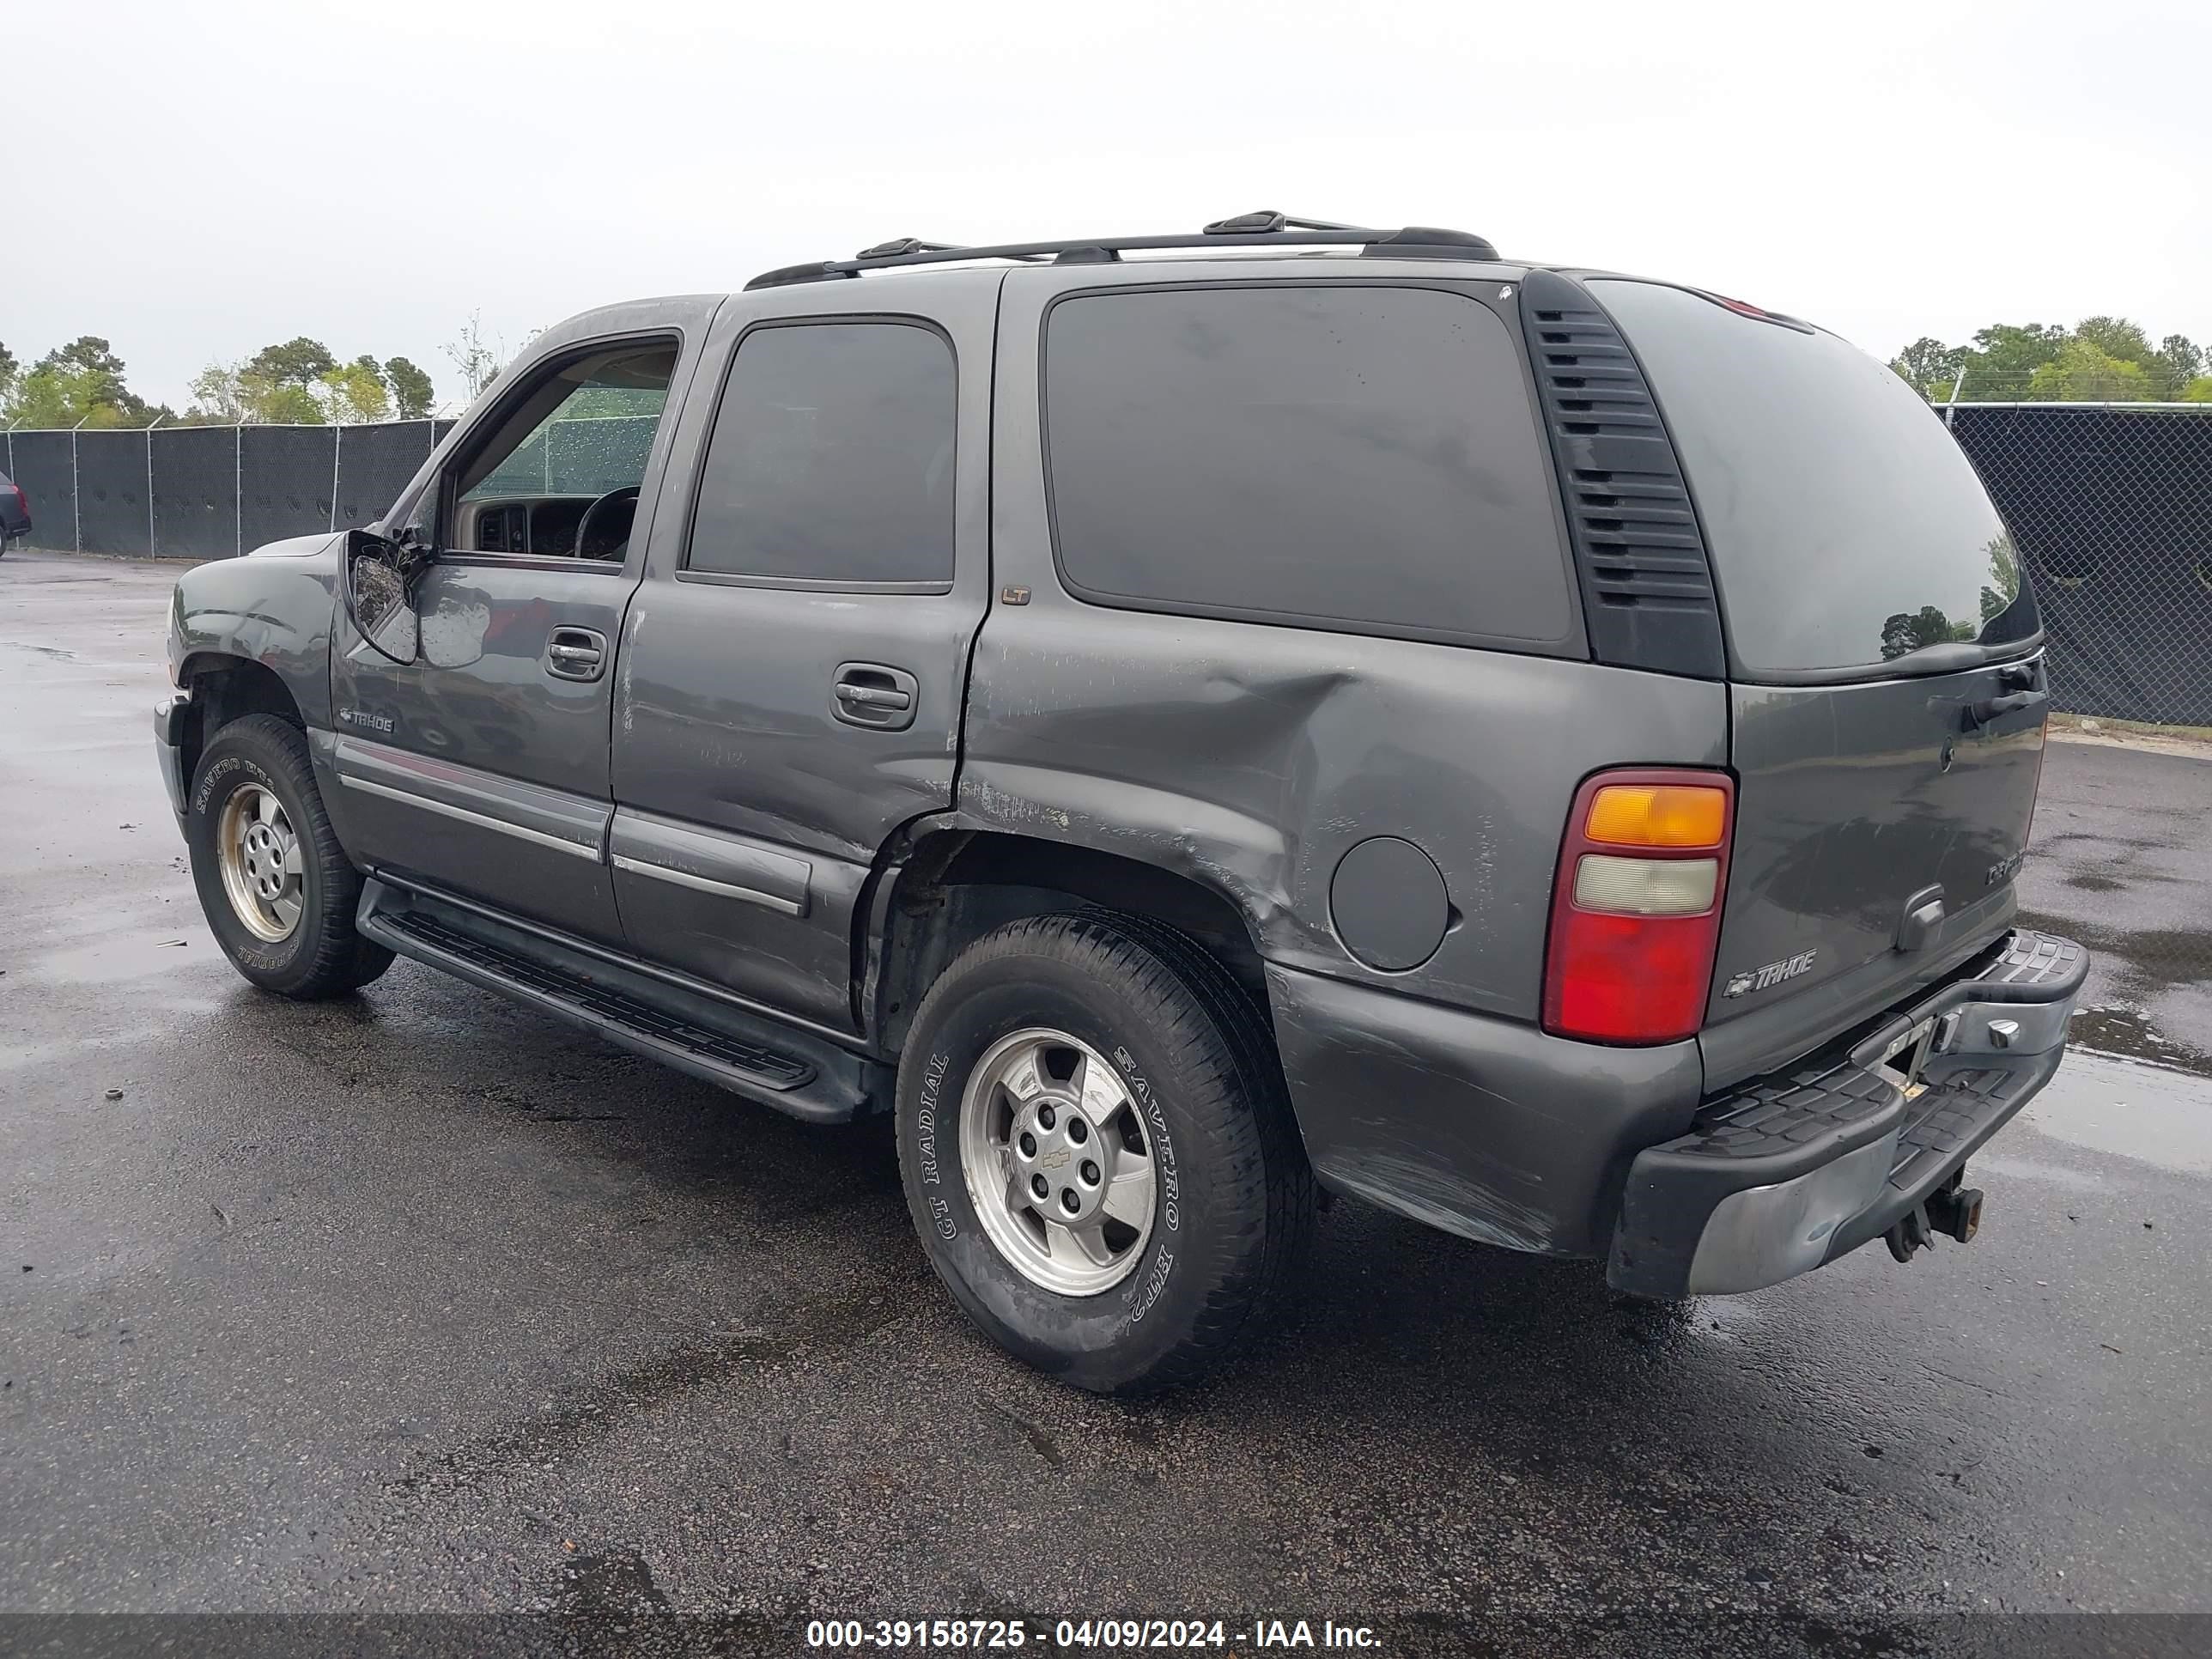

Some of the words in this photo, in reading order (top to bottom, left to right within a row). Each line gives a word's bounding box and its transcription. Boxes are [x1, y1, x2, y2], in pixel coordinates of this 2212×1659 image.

[1002, 588, 1029, 602] LT
[352, 711, 394, 733] TAHOE
[196, 757, 241, 815] SAVERO
[237, 945, 287, 969] RADIAL
[1755, 947, 1818, 990] TAHOE
[918, 1053, 951, 1185] RADIAL
[1113, 1044, 1181, 1232] SAVERO
